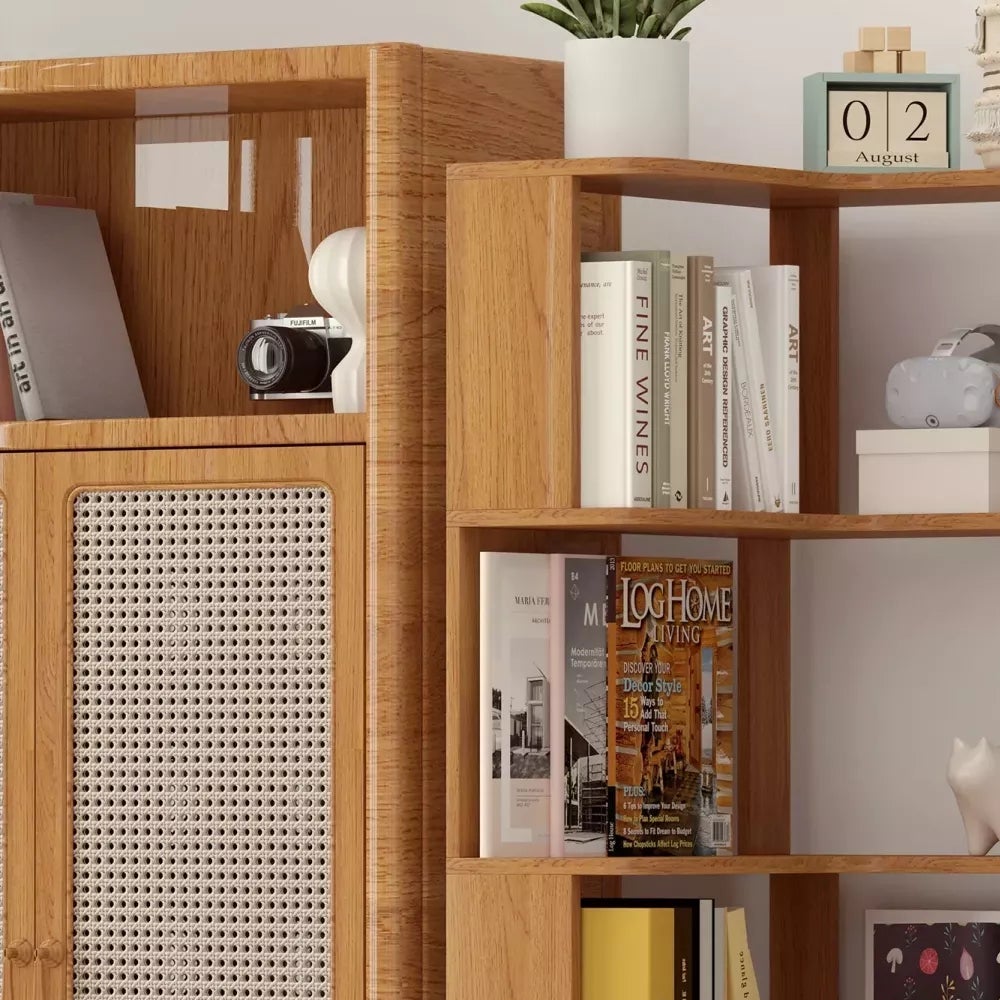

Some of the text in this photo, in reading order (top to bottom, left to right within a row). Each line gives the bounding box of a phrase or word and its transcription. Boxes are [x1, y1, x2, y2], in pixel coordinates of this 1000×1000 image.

[855, 151, 919, 166] August
[636, 295, 649, 361] FINE
[702, 315, 713, 356] ART
[6, 334, 22, 357] in
[788, 324, 799, 363] ART
[12, 361, 31, 393] art
[636, 376, 649, 474] WINES
[620, 561, 731, 575] FLOOR PLANS TO GET YOU STARTED
[653, 624, 700, 643] LIVING
[623, 662, 671, 674] DISCOVER YOUR
[623, 678, 682, 697] Decor Style
[623, 697, 639, 719] 15
[640, 696, 664, 707] Ways to
[640, 709, 667, 719] Add That
[623, 722, 669, 732] Personal Touch
[623, 786, 645, 797] PLUS:
